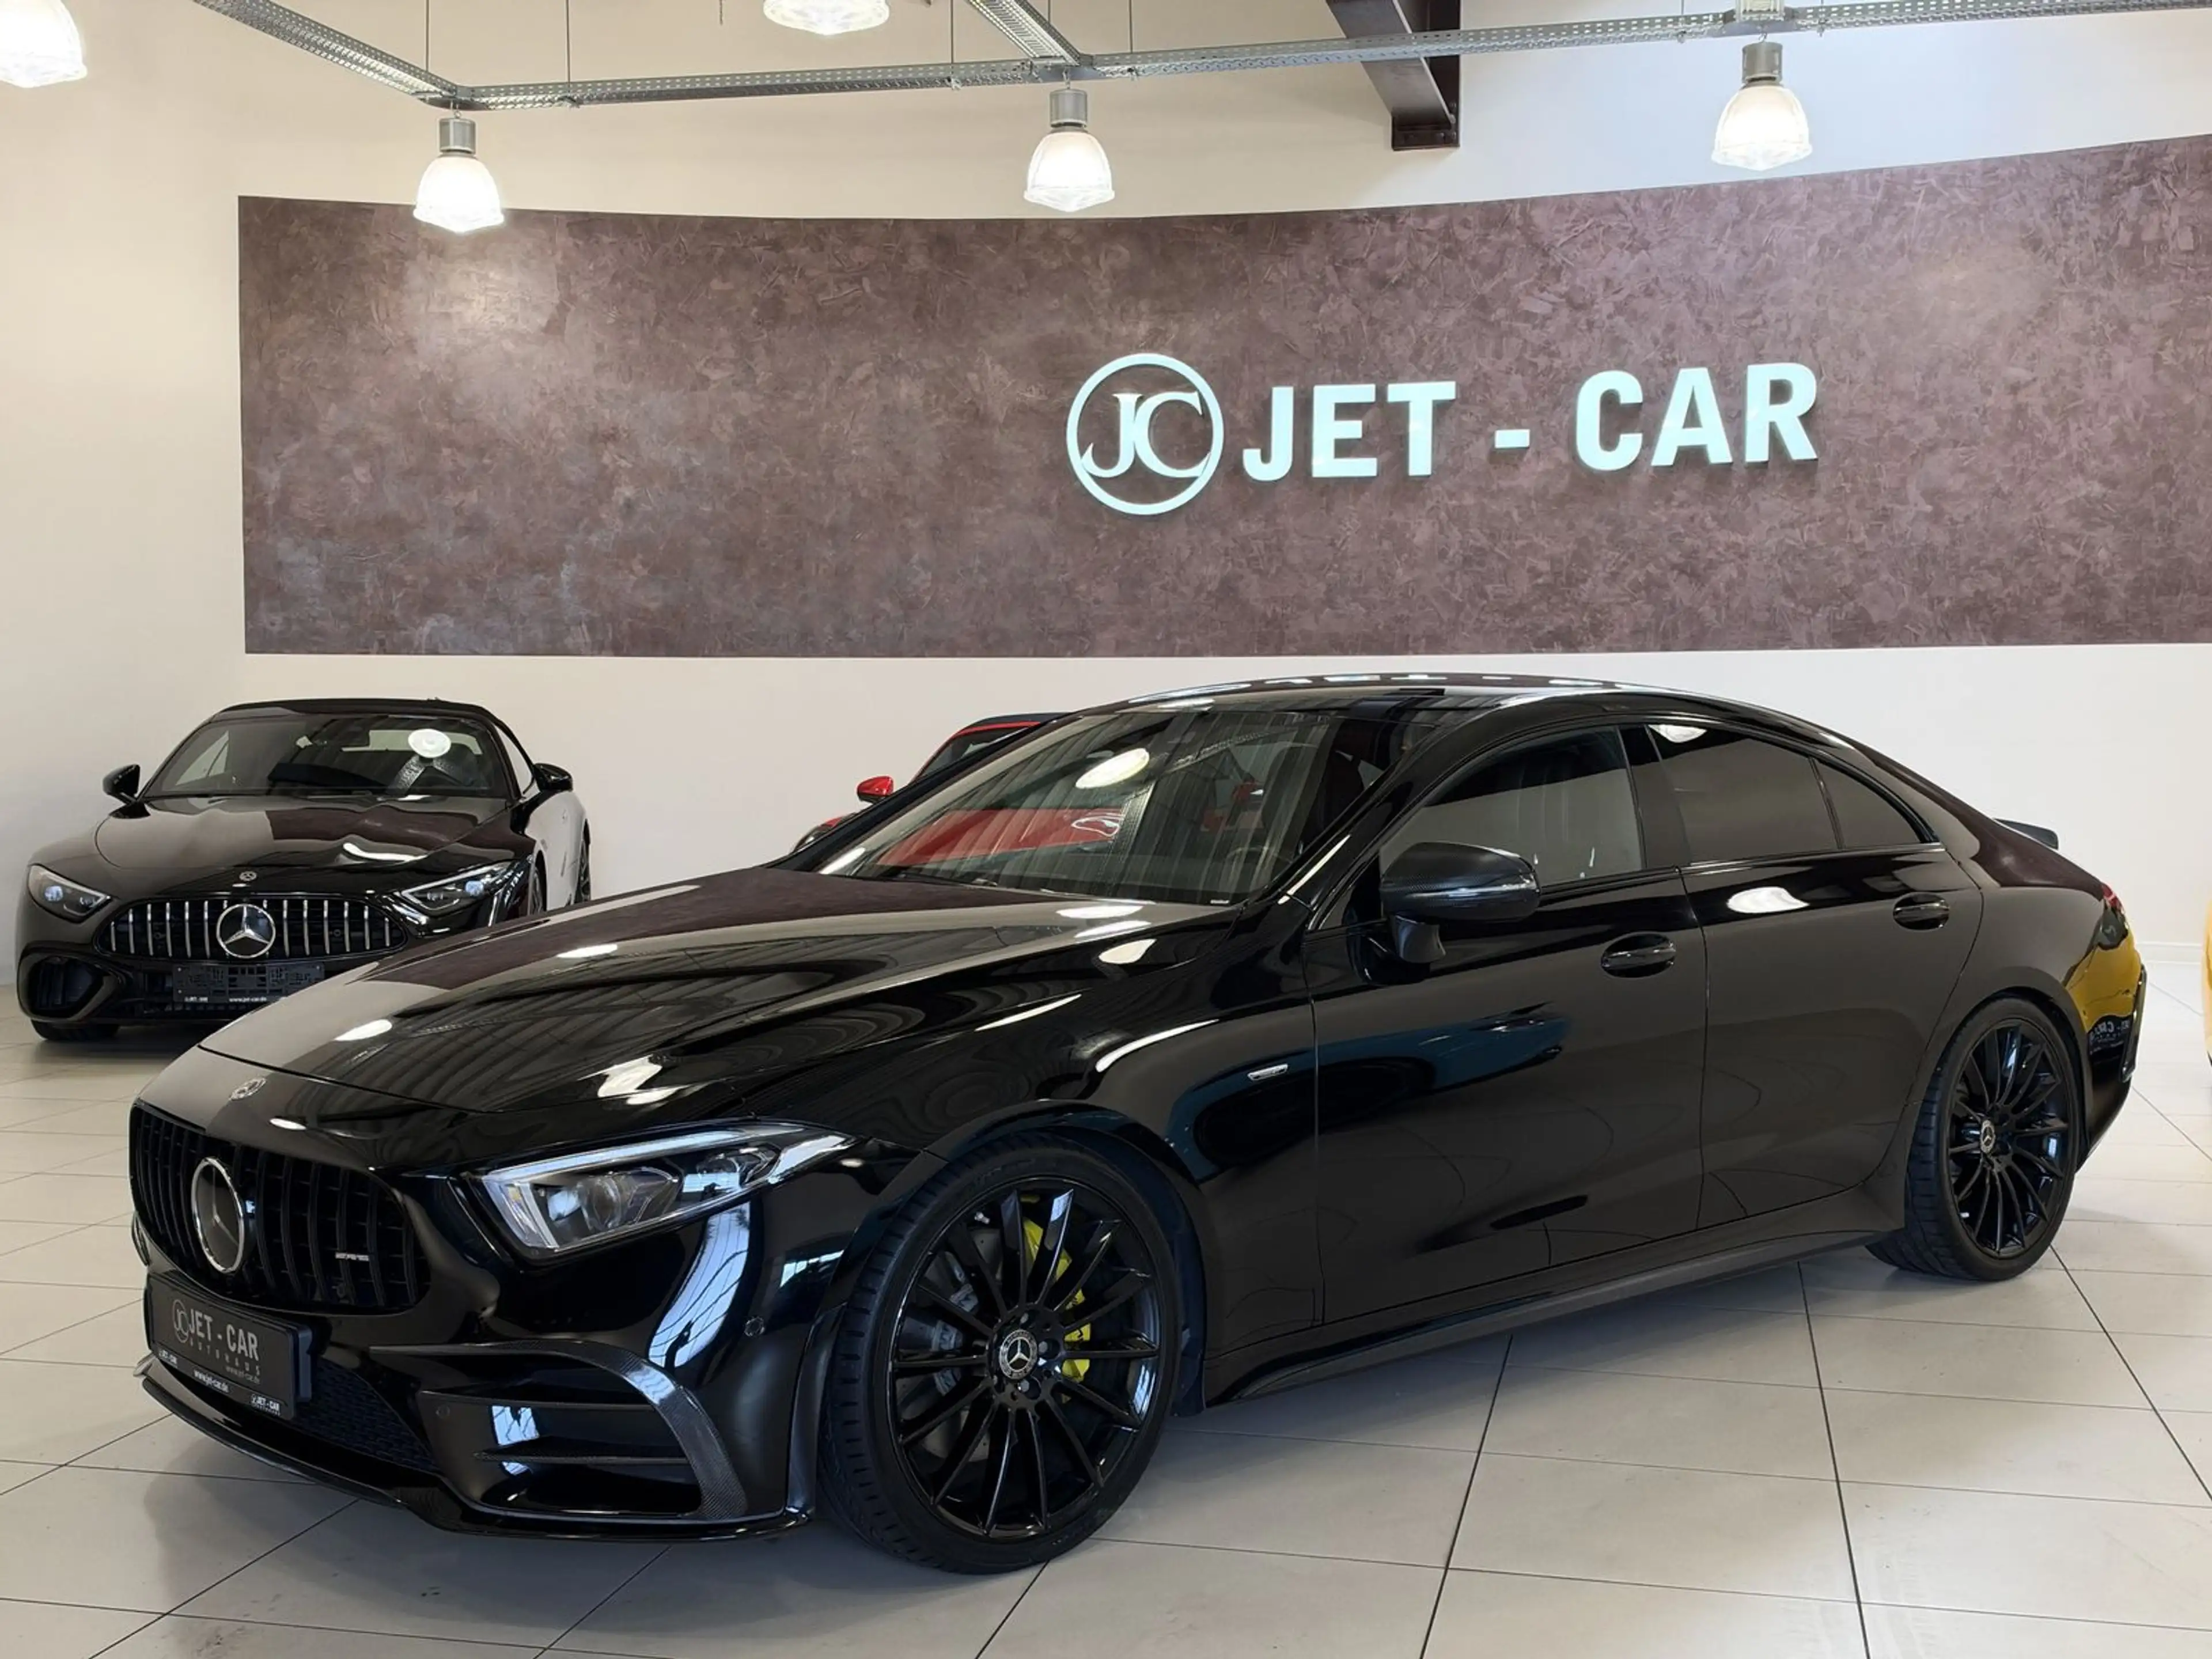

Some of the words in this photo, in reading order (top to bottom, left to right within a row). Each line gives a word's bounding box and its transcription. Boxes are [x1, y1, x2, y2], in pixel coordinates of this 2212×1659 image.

[1081, 391, 1210, 478] JC
[1242, 381, 1456, 482] JET
[1495, 429, 1530, 448] -
[1575, 362, 1818, 471] CAR
[189, 1308, 213, 1342] JET
[226, 1324, 259, 1361] CAR
